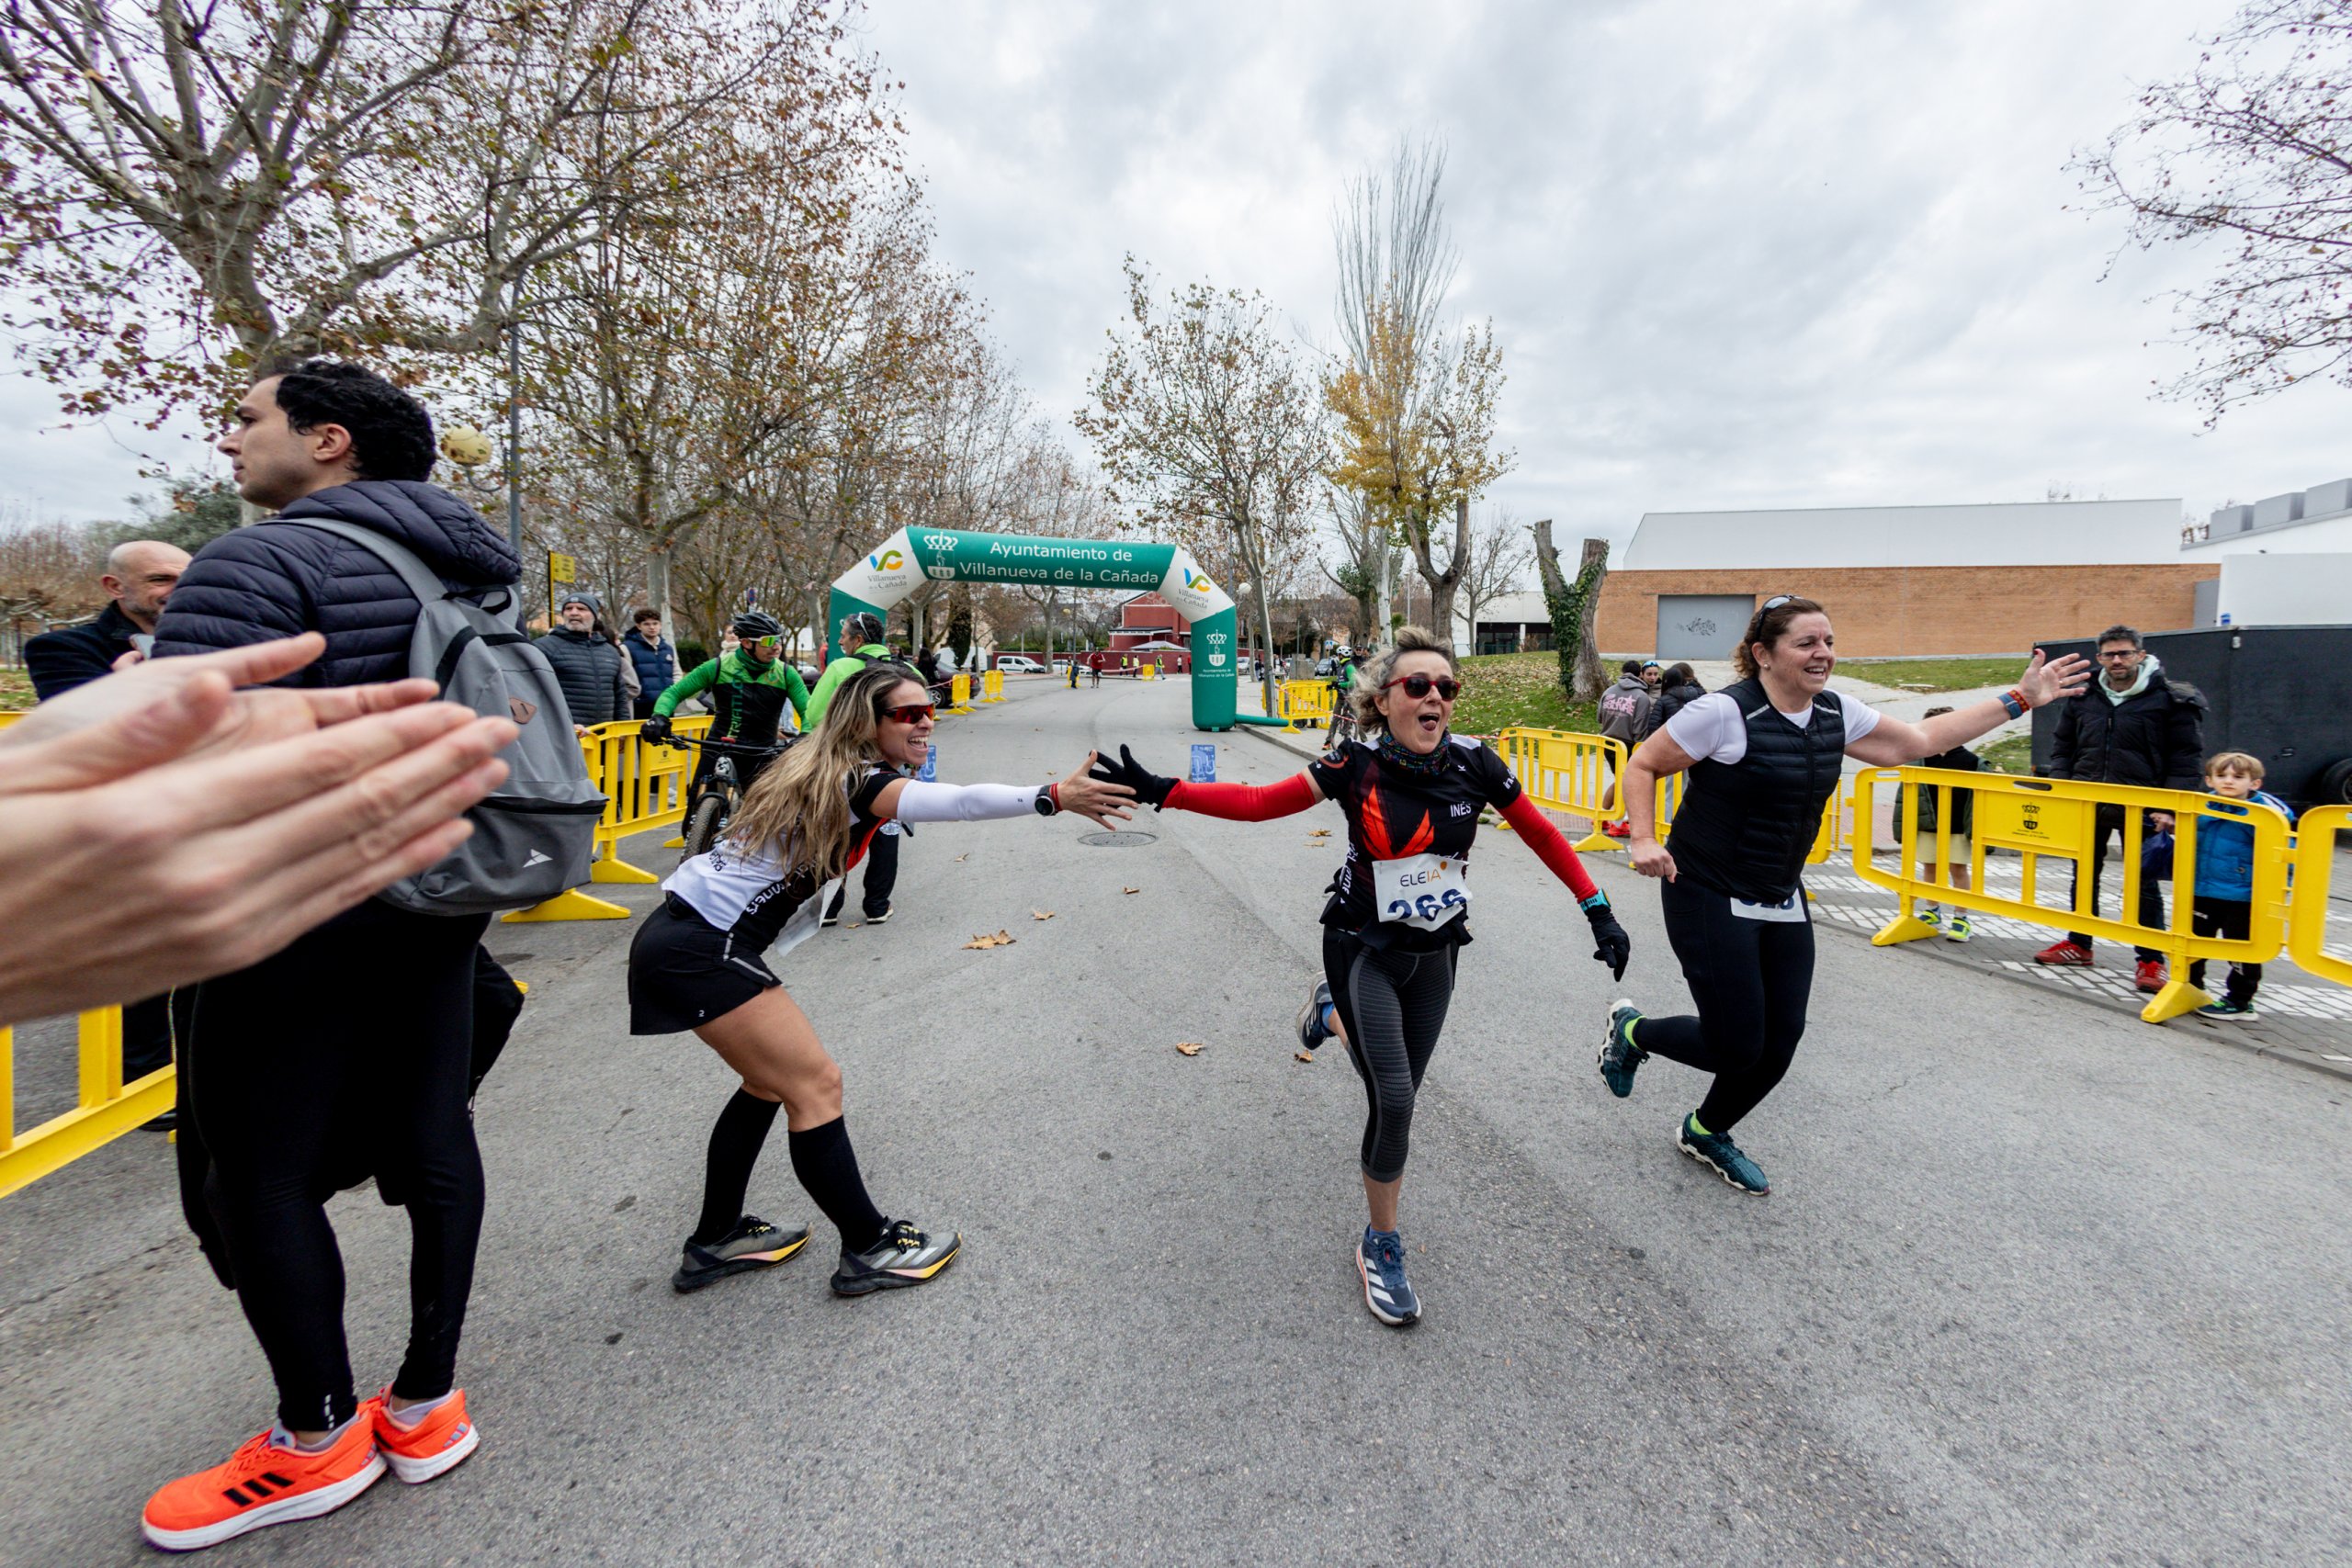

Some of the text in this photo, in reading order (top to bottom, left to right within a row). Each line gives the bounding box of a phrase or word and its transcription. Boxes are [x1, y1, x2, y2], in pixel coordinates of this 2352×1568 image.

[989, 542, 1132, 561] Ayuntamiento de
[867, 574, 907, 582] Villanueva
[959, 561, 1159, 583] Villanueva de la Cañada
[1450, 800, 1472, 818] INÉS
[1400, 868, 1442, 887] ELEIA
